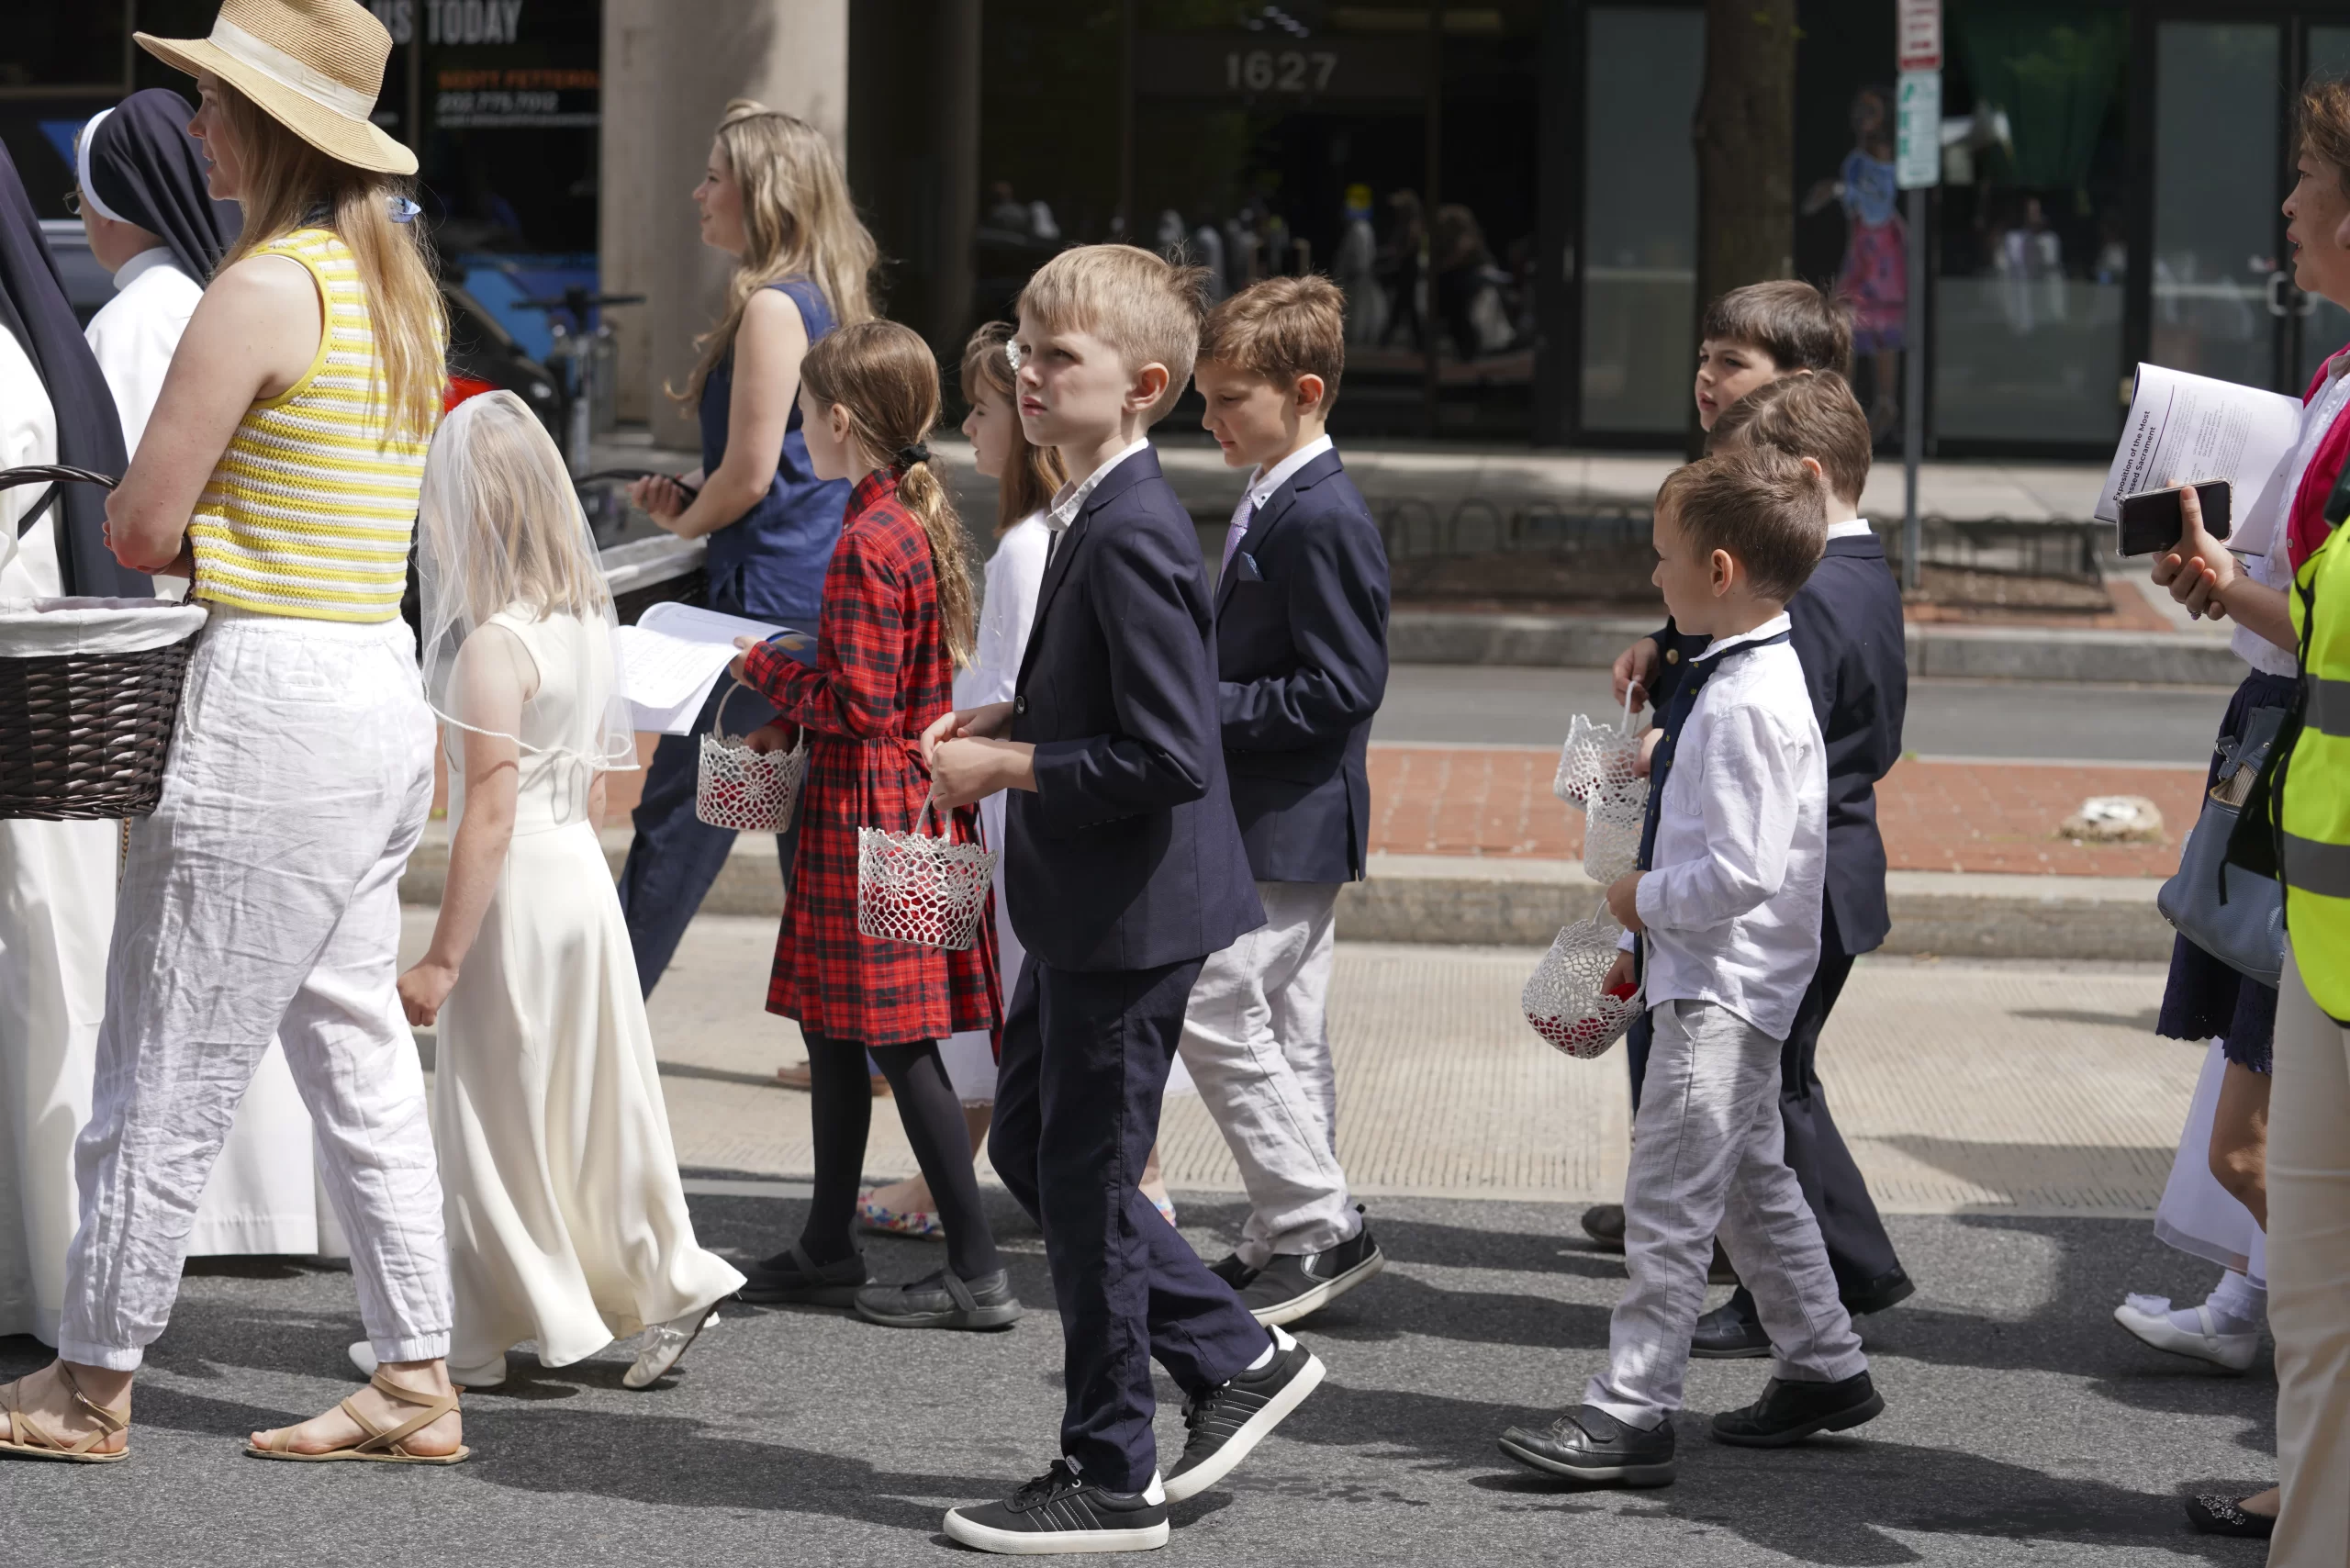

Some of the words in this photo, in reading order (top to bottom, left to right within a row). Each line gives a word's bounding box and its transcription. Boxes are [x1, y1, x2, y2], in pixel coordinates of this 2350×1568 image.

[370, 0, 413, 44] US
[428, 0, 522, 44] TODAY
[1225, 50, 1338, 91] 1627
[2132, 432, 2142, 446] the
[2138, 410, 2150, 431] Most
[2127, 472, 2140, 494] essed
[2135, 426, 2155, 471] Sacrament
[2130, 447, 2136, 456] of
[2113, 458, 2133, 500] Exposition
